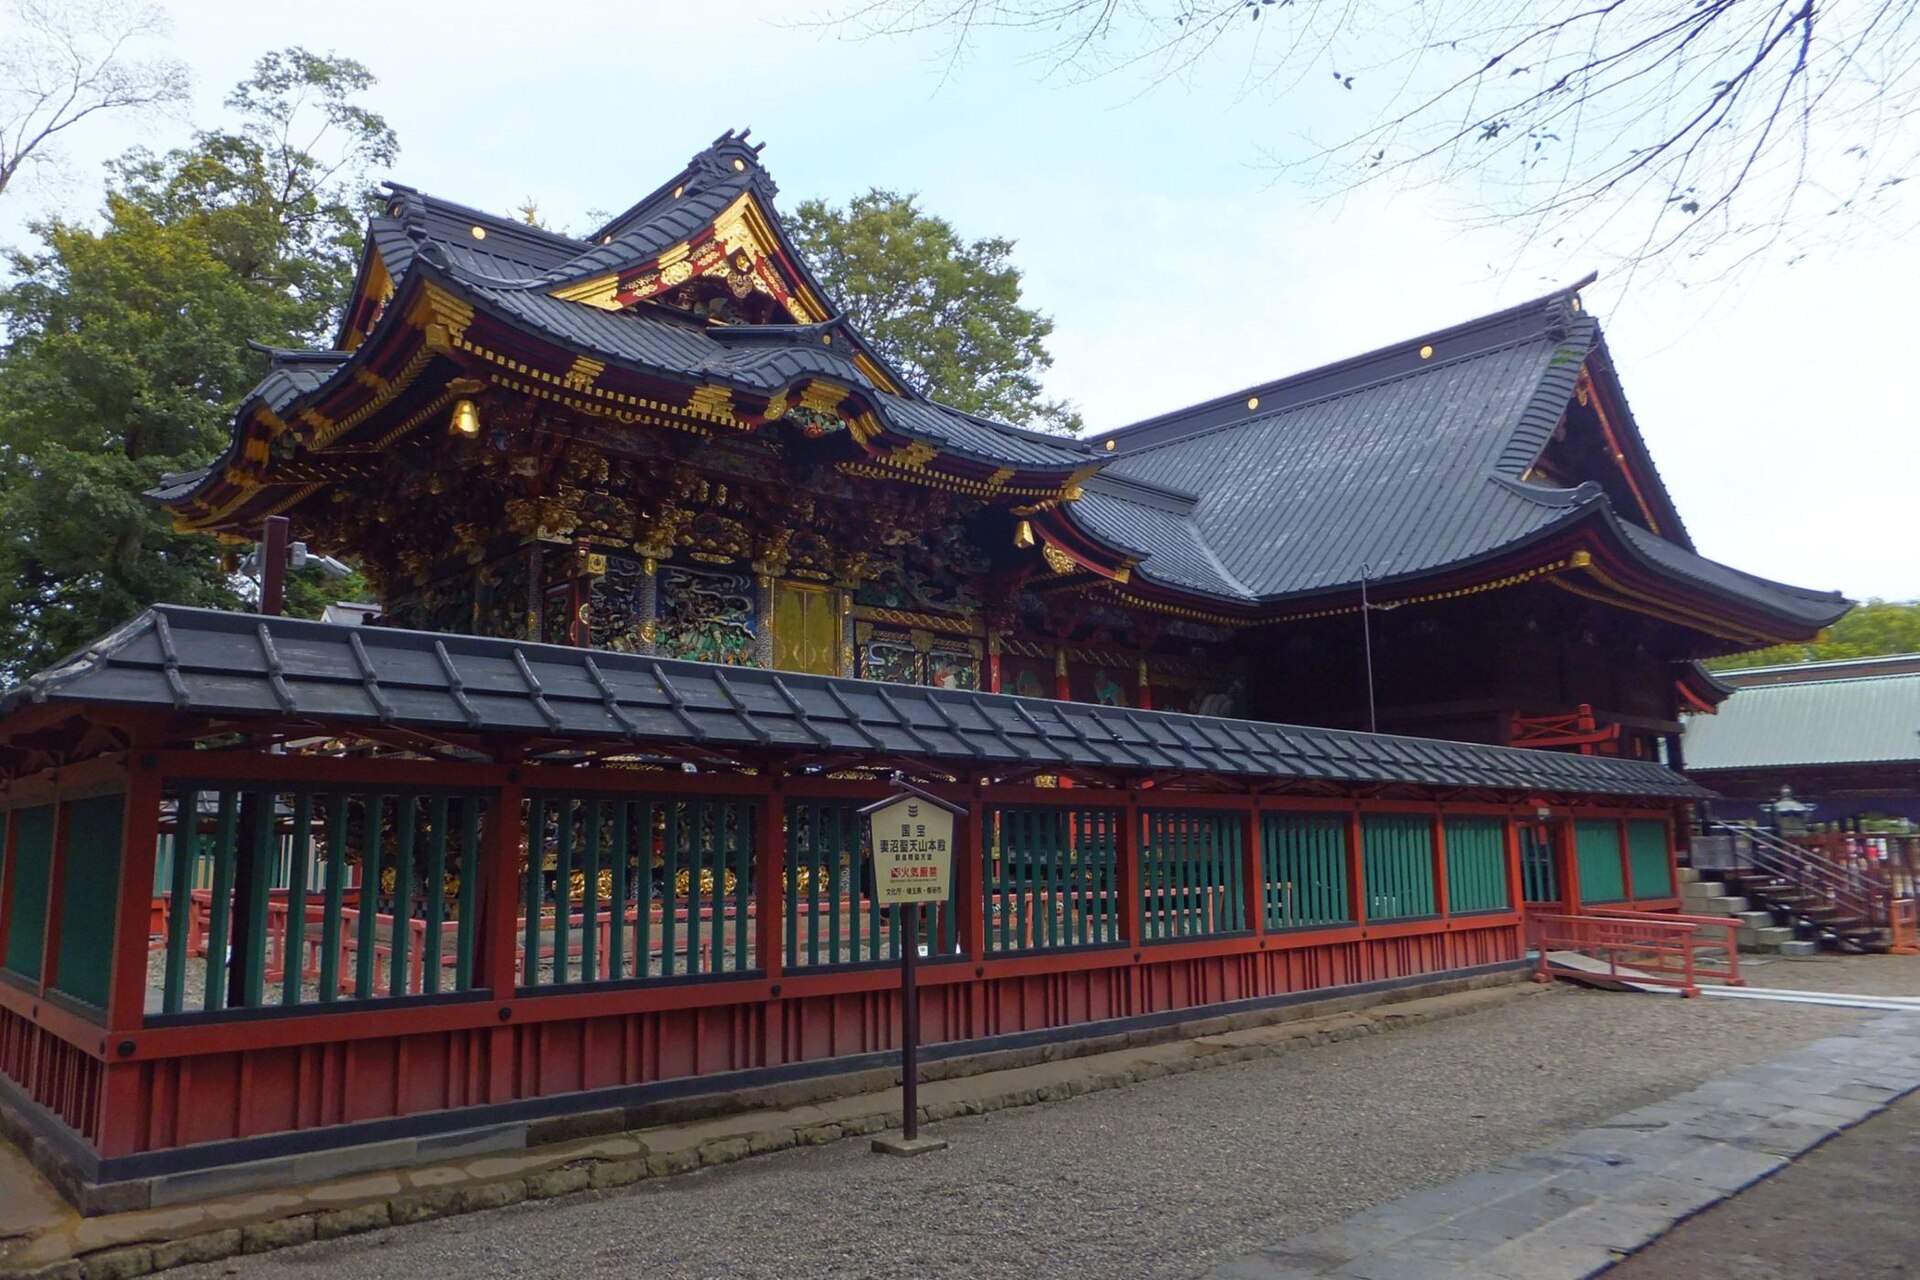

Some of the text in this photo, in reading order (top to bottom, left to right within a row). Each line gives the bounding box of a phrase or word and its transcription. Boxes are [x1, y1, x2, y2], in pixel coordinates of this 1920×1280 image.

[880, 839, 946, 853] 妻沼聖天山本殿
[901, 866, 938, 878] 火気厳禁
